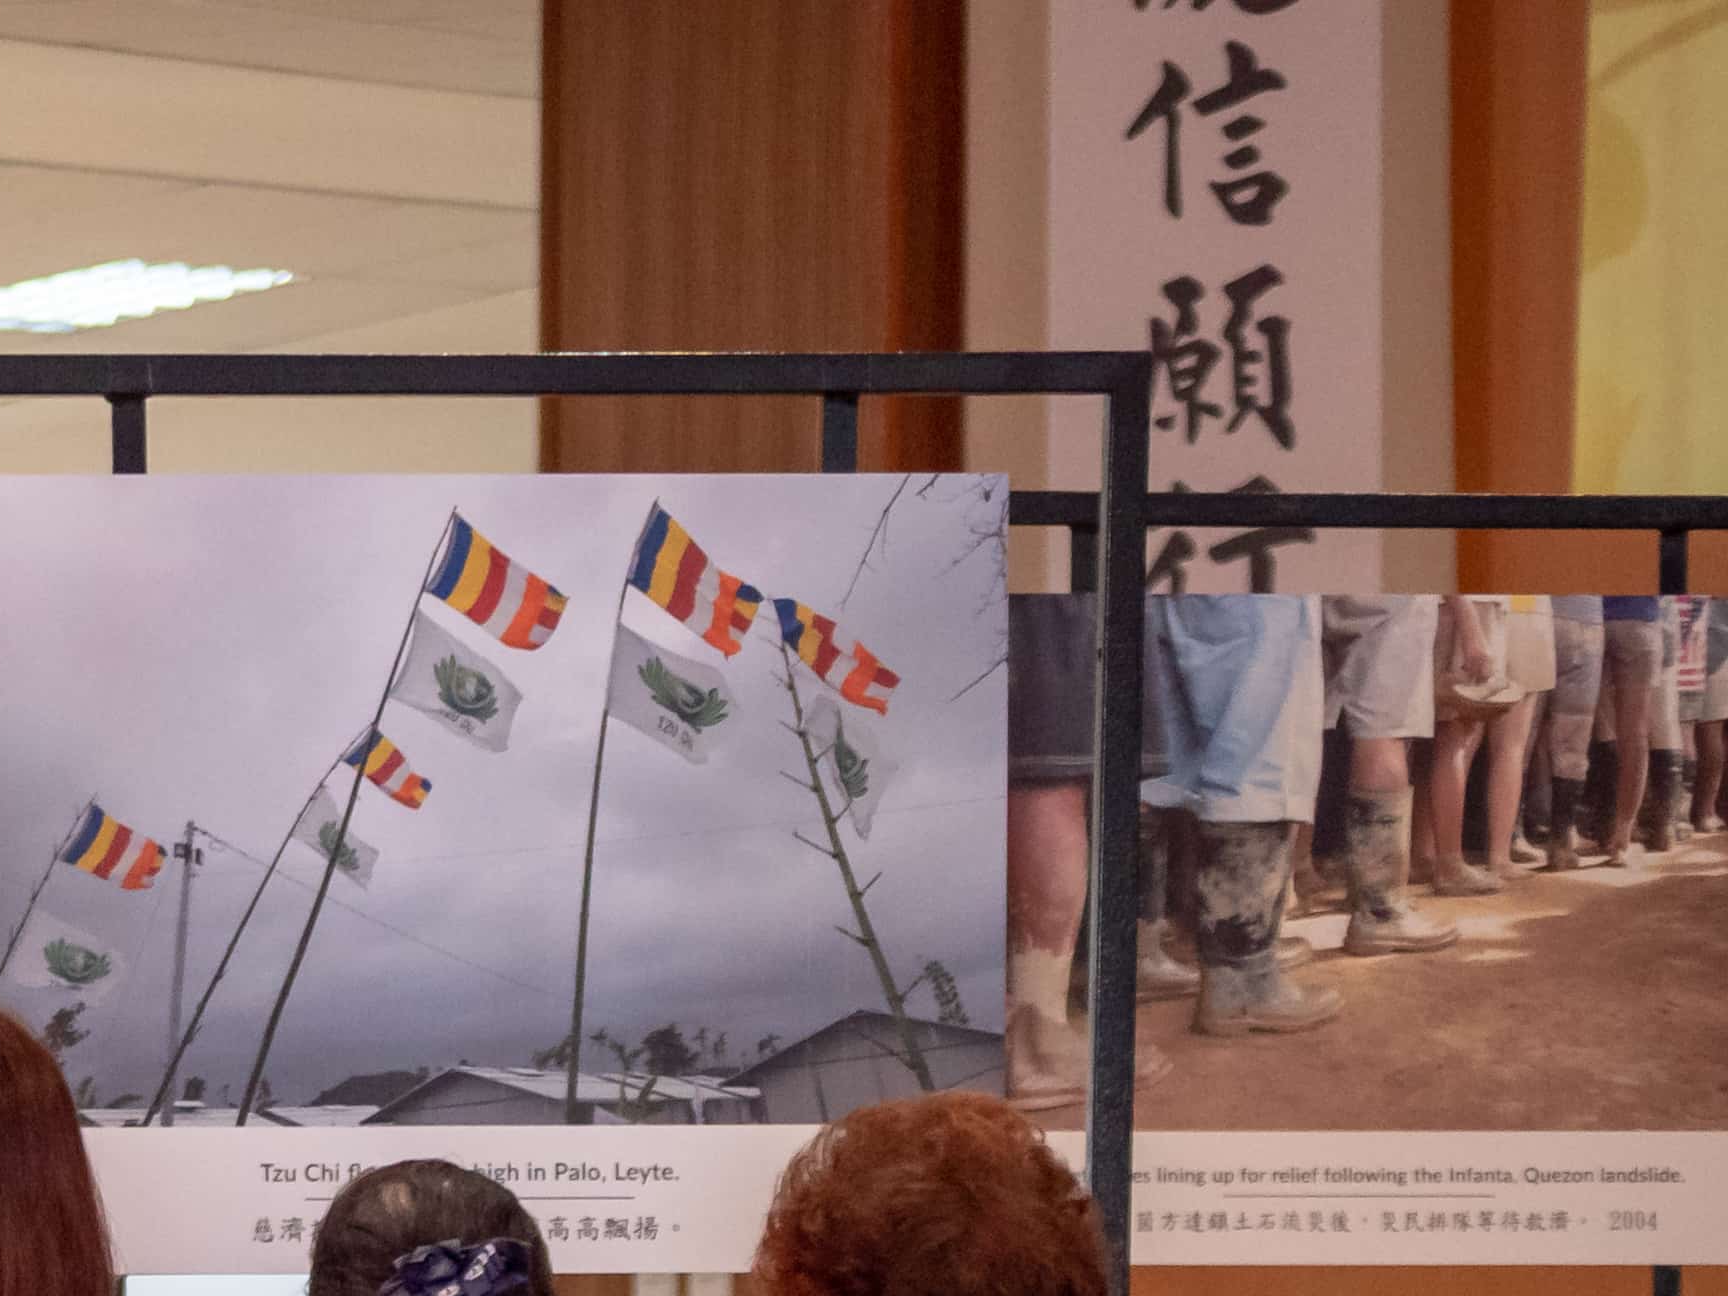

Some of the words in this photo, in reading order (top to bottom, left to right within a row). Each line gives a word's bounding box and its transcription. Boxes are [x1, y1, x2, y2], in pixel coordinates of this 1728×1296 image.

[259, 1162, 297, 1183] Tzu
[303, 1162, 341, 1183] Chi
[527, 1161, 547, 1182] in
[554, 1161, 607, 1184] Palo,
[614, 1161, 680, 1185] Leyte.
[1156, 1167, 1207, 1188] lining
[1210, 1170, 1235, 1186] up
[1239, 1167, 1269, 1185] for
[1270, 1166, 1321, 1184] relief
[1321, 1166, 1409, 1187] following
[1412, 1167, 1444, 1184] the
[1448, 1167, 1519, 1185] Infanta,
[1522, 1166, 1595, 1185] Quezon
[1598, 1166, 1686, 1184] landslide.
[1607, 1210, 1659, 1232] 2004
